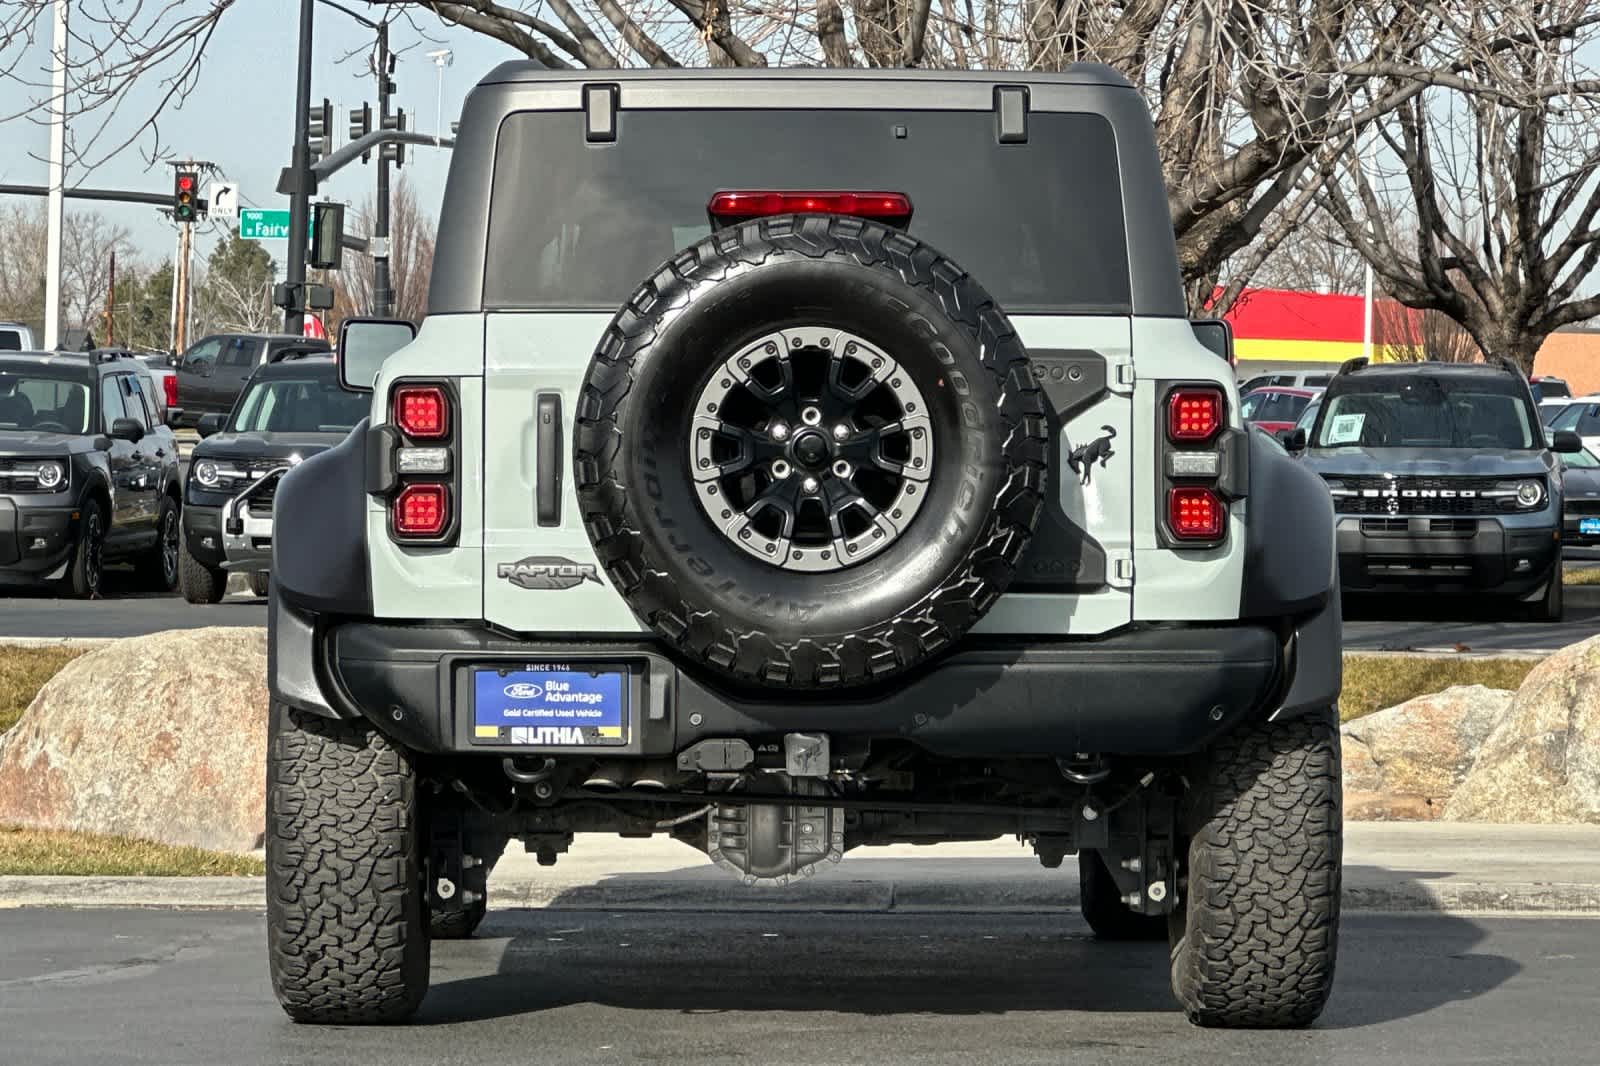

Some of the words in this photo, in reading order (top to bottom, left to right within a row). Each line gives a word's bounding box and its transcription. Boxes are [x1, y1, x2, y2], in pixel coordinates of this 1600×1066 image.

[211, 207, 233, 215] ONLY
[1363, 490, 1476, 498] BRONCO
[498, 563, 597, 579] RAPTOR
[511, 685, 536, 697] Ford
[545, 681, 569, 691] Blue
[545, 692, 602, 704] Advantage
[503, 709, 521, 717] Gold
[522, 708, 554, 717] Certified
[555, 709, 574, 717] Used
[576, 708, 602, 717] Vehicle
[528, 727, 584, 744] LITHIA
